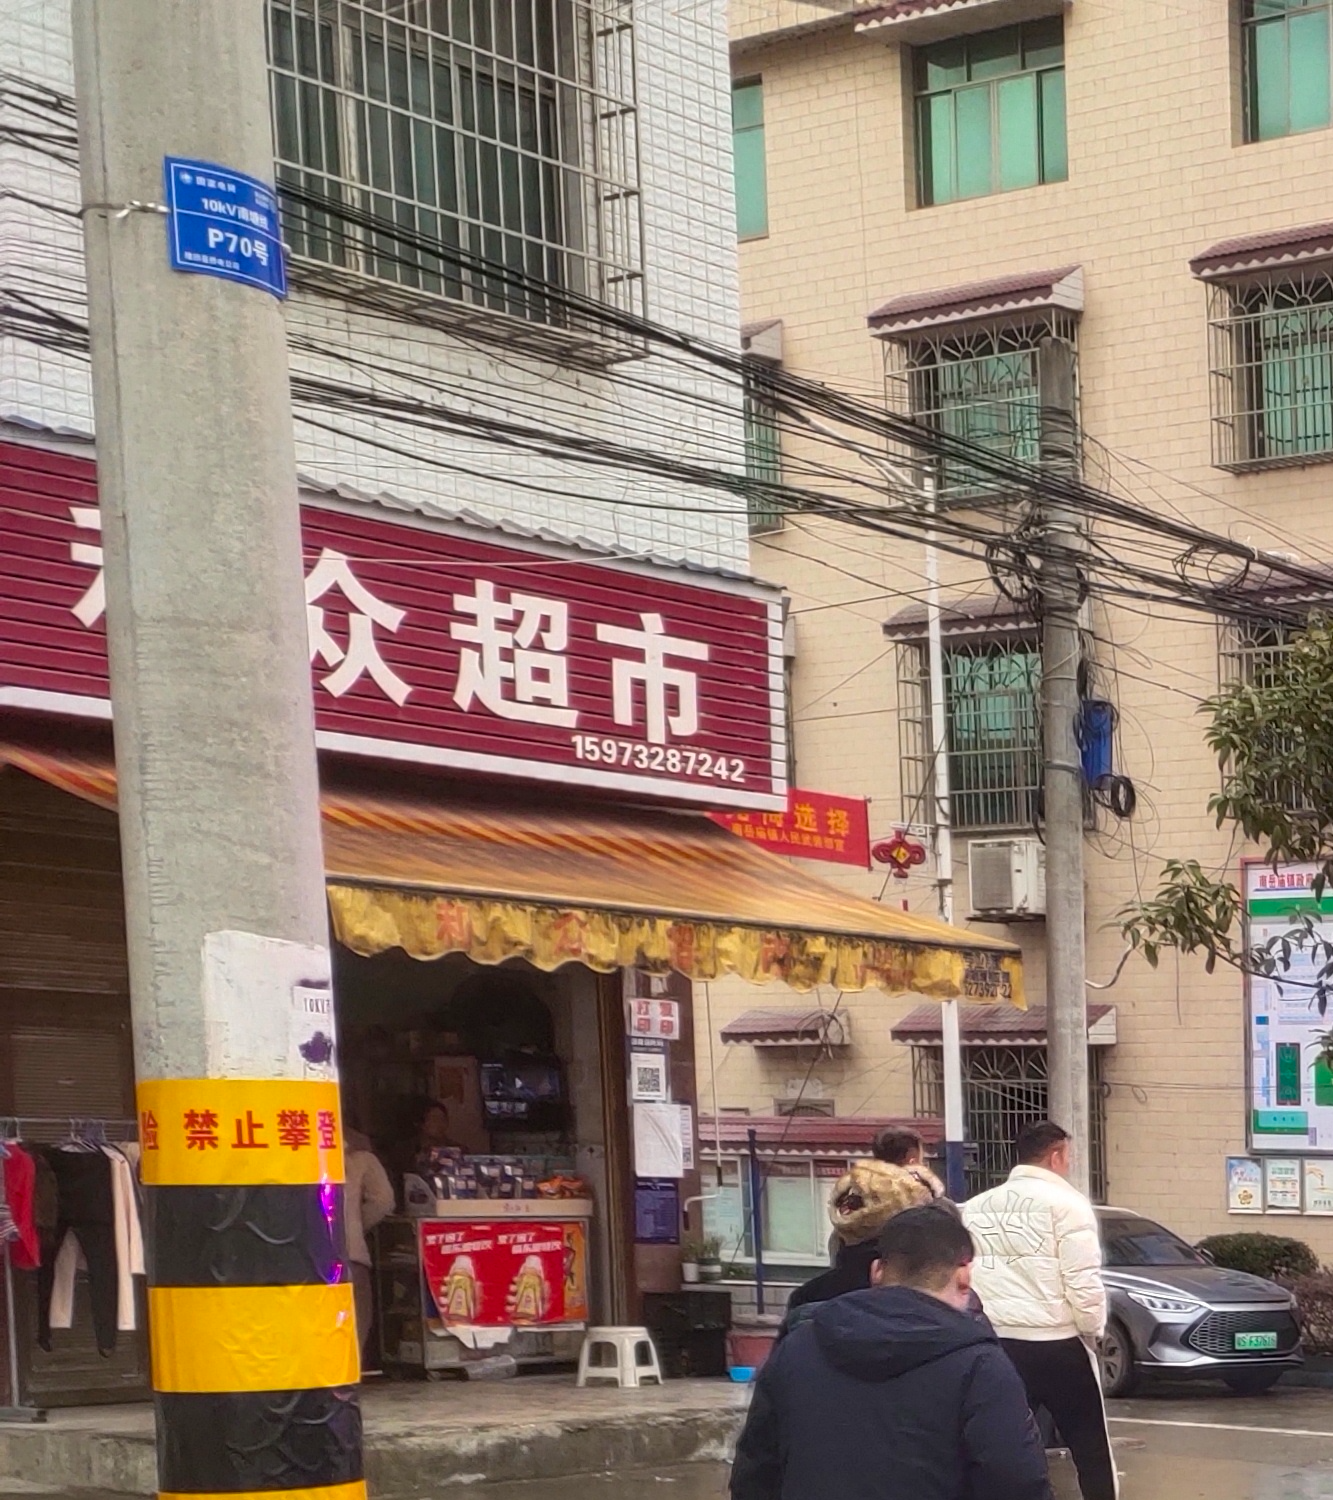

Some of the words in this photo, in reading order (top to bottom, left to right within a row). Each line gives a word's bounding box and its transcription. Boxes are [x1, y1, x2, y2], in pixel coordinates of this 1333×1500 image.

[208, 227, 269, 267] P70号
[69, 506, 710, 745] 众超市
[571, 734, 747, 784] 15973287242
[184, 1109, 337, 1151] 禁止攀登
